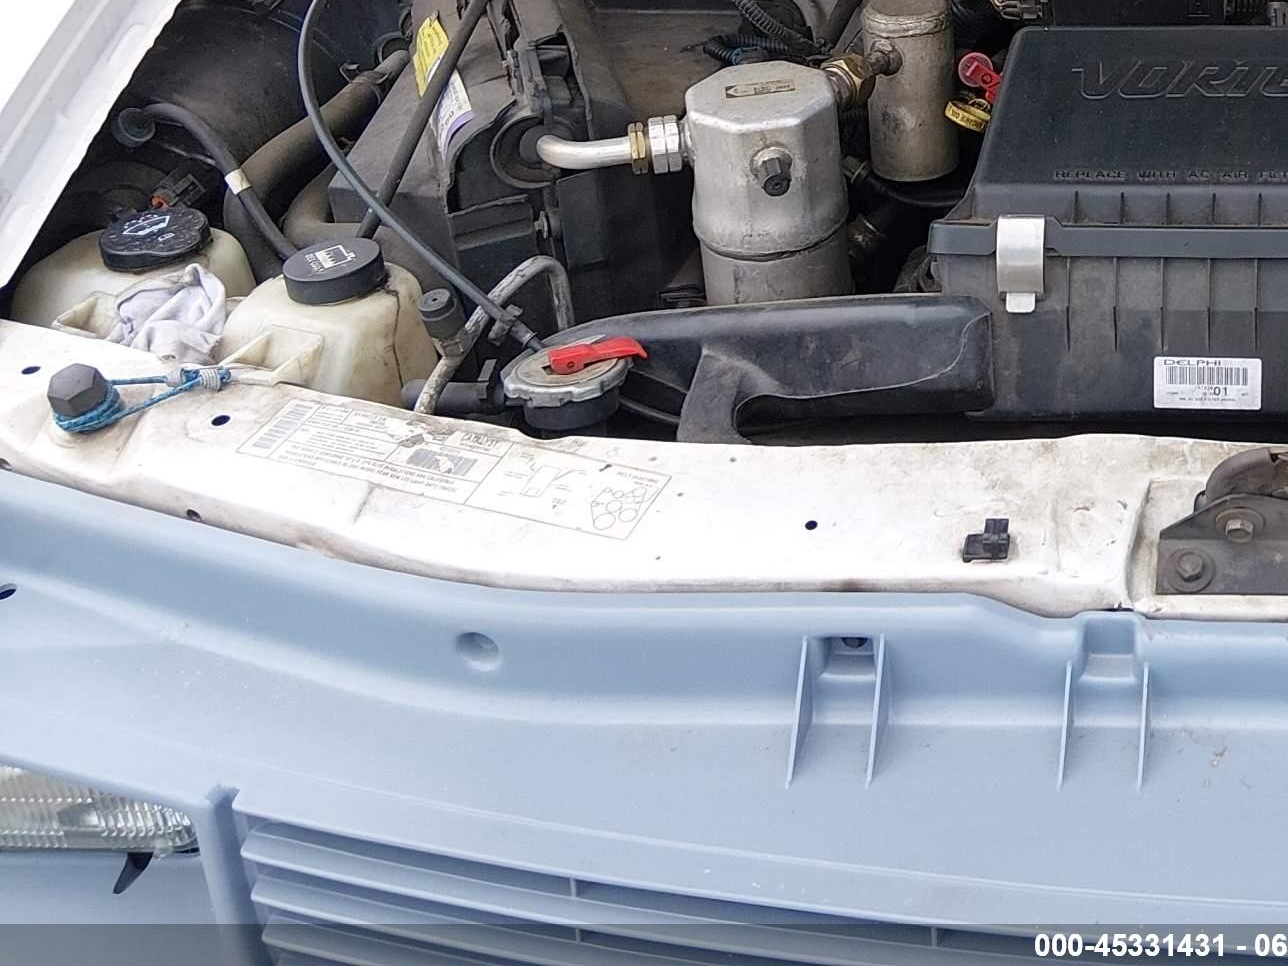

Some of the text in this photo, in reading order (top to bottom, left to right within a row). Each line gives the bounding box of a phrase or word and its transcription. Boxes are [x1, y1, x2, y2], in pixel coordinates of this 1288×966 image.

[1054, 169, 1126, 181] REPLACE
[1137, 169, 1177, 181] WITH
[1187, 169, 1209, 181] AC
[1222, 169, 1248, 181] AIR
